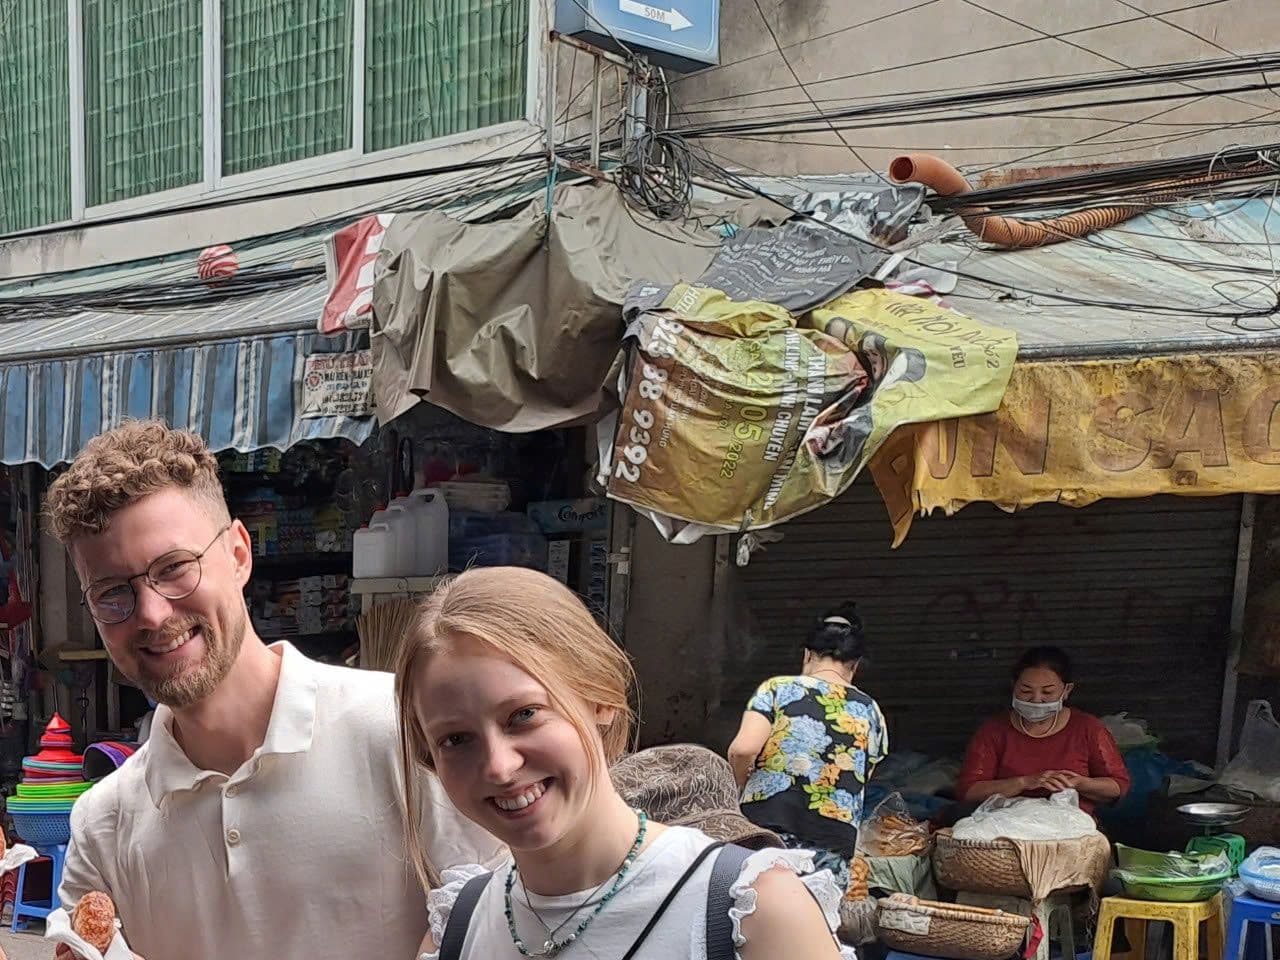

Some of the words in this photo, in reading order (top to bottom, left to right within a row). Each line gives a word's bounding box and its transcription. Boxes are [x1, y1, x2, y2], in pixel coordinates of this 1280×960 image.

[950, 345, 966, 369] YÊU
[615, 409, 654, 482] 9392
[764, 411, 792, 461] CHUYÊN
